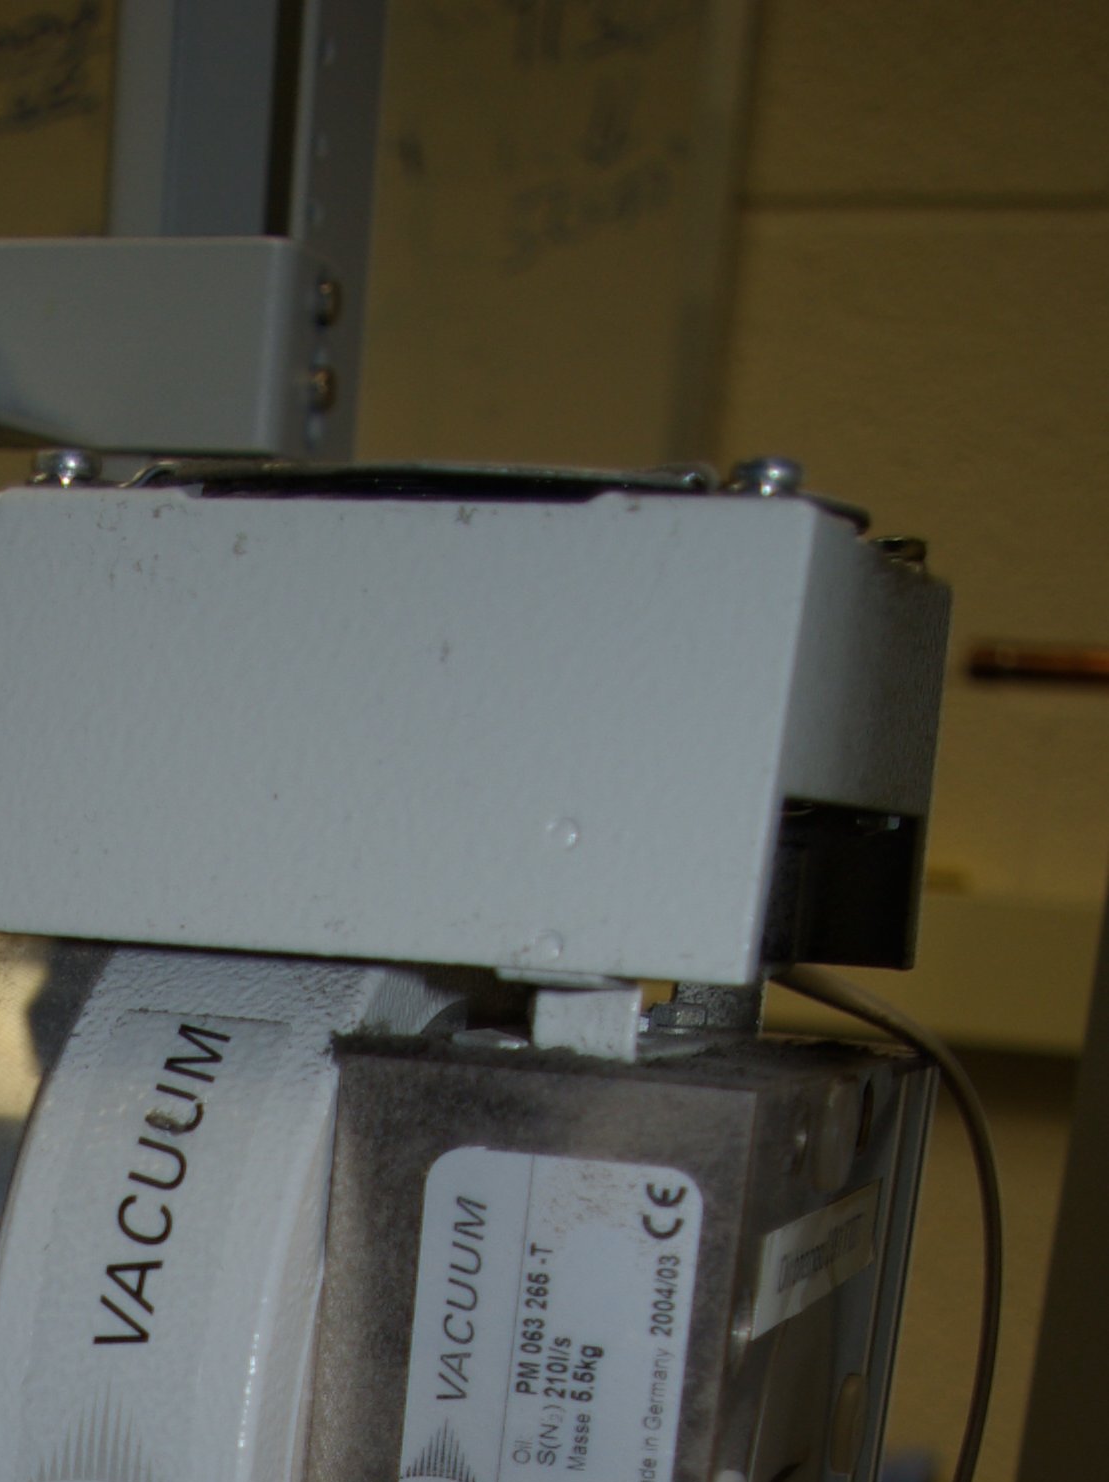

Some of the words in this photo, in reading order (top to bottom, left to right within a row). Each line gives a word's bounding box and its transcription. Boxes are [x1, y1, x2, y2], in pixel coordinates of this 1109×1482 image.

[93, 1021, 232, 1347] VACUUM
[436, 1196, 487, 1400] VACUUM
[650, 1254, 680, 1338] 2004/03
[520, 1317, 545, 1354] 063
[516, 1362, 540, 1396] PM
[643, 1346, 673, 1431] Germany
[567, 1413, 591, 1471] Masse
[644, 1436, 660, 1451] in
